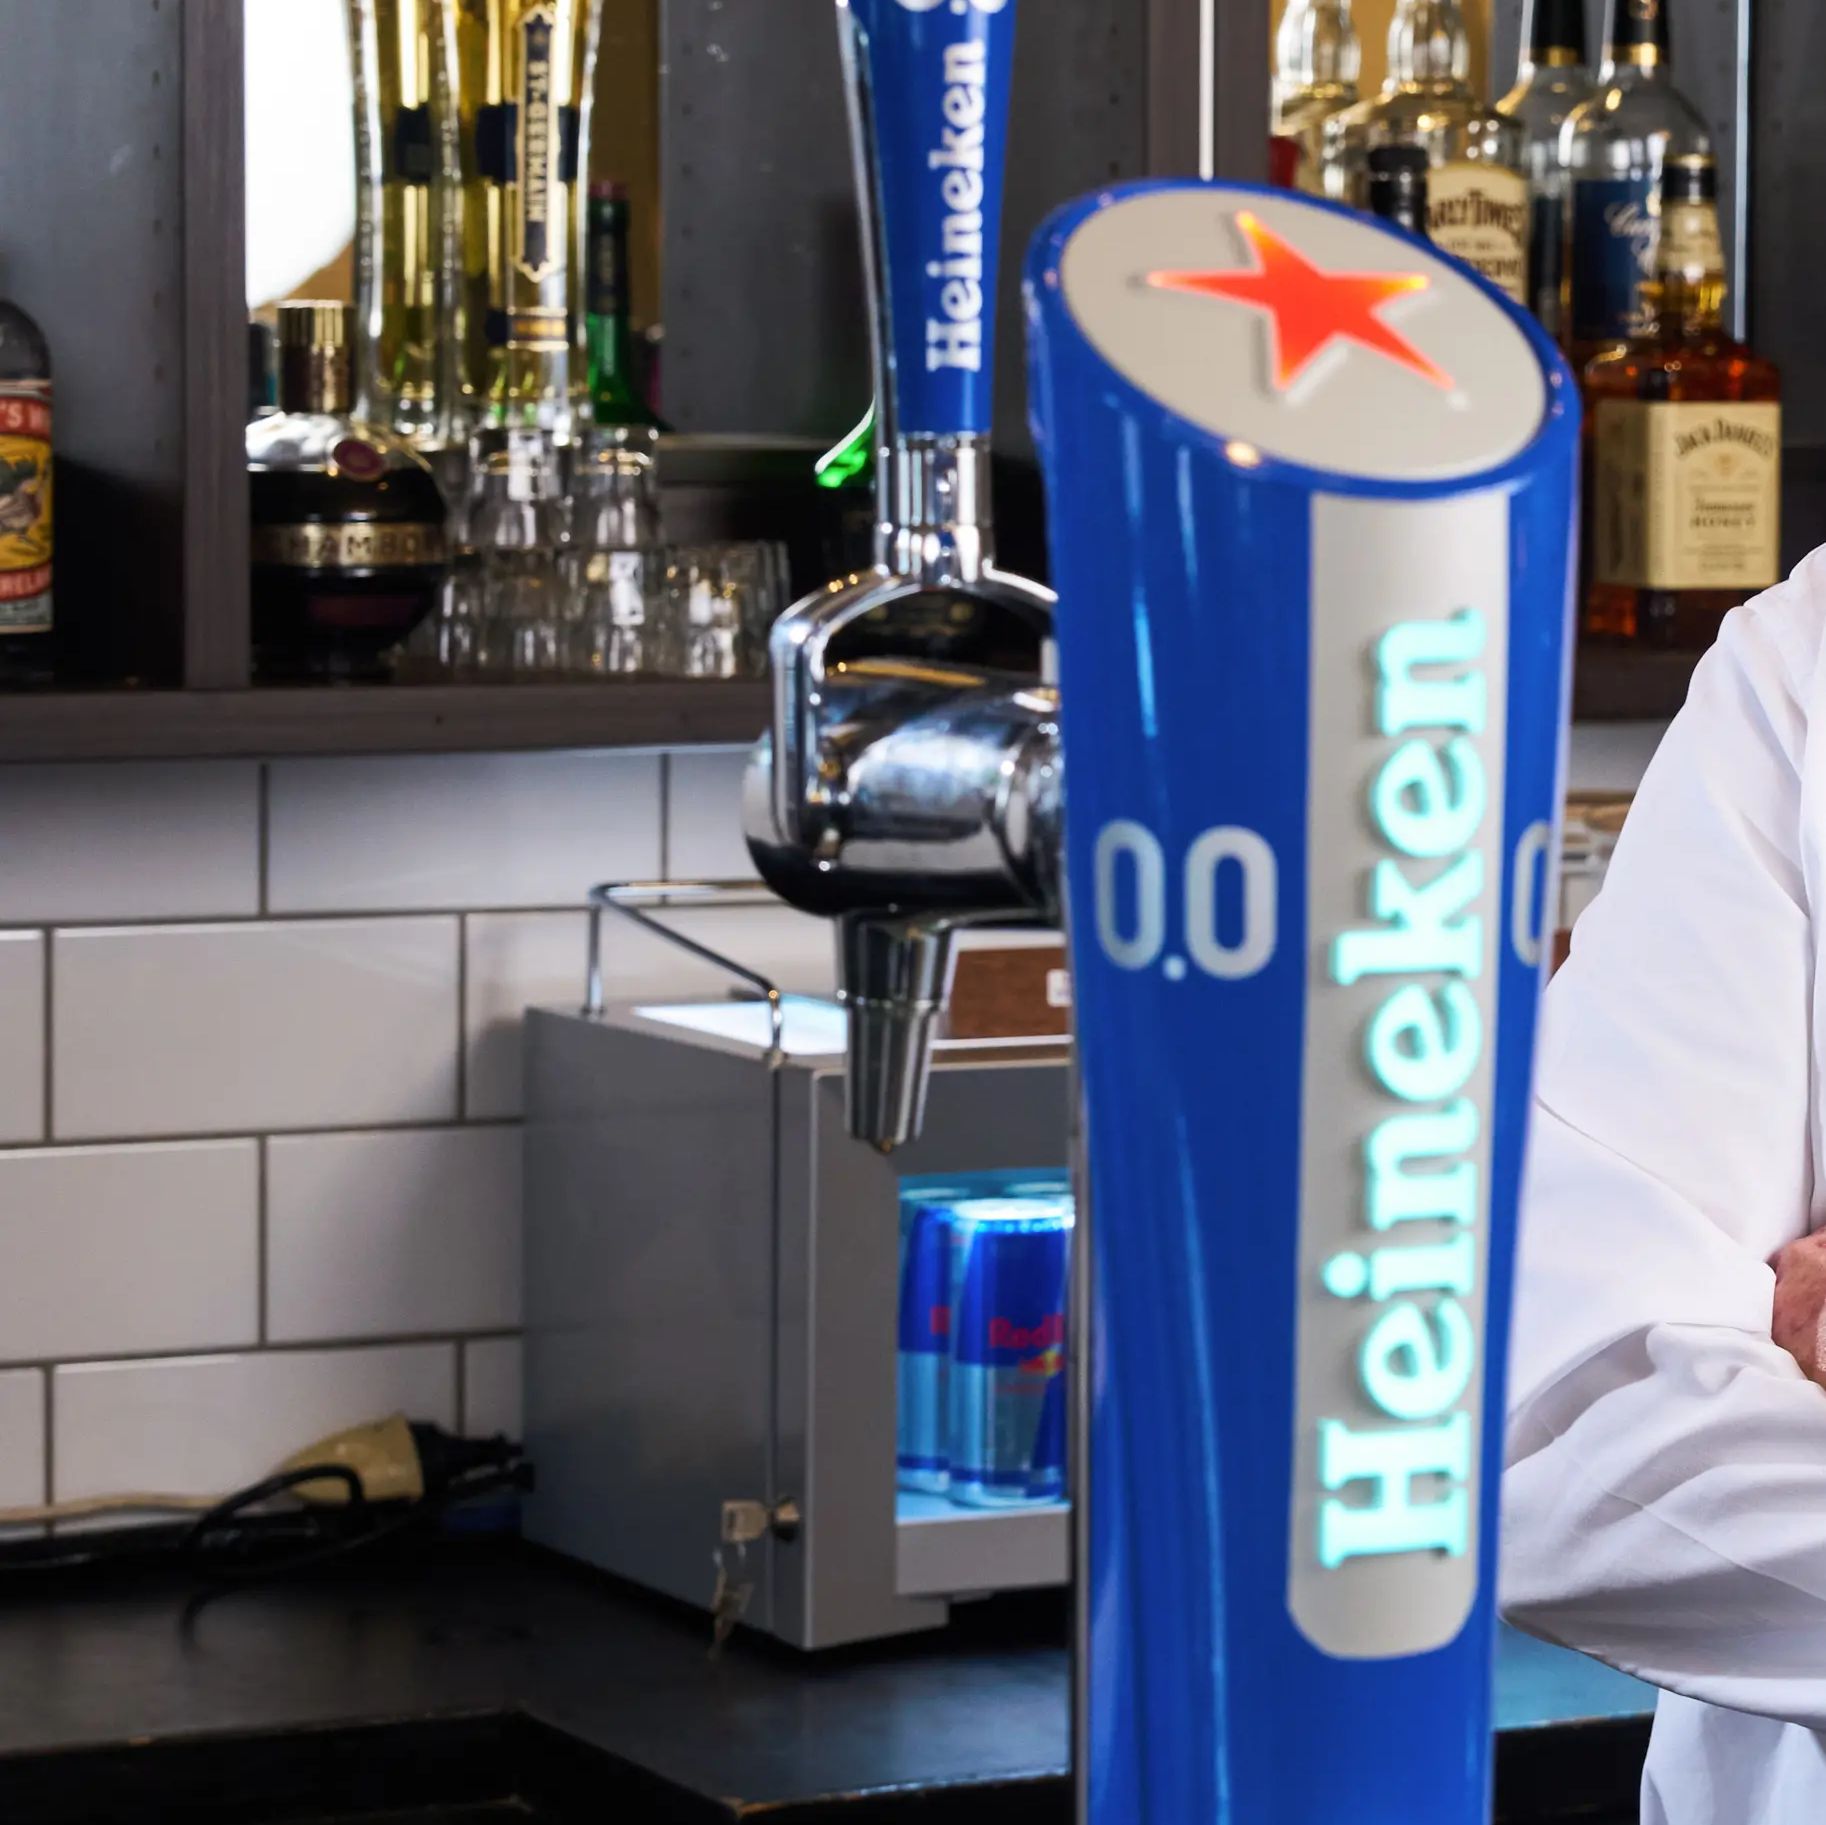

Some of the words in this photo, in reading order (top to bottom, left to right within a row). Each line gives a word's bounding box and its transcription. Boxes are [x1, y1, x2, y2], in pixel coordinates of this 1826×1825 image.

[924, 38, 988, 373] Heineken
[1092, 818, 1278, 982] 0.0
[1316, 604, 1490, 1572] Heineken
[988, 1314, 1064, 1349] Red
